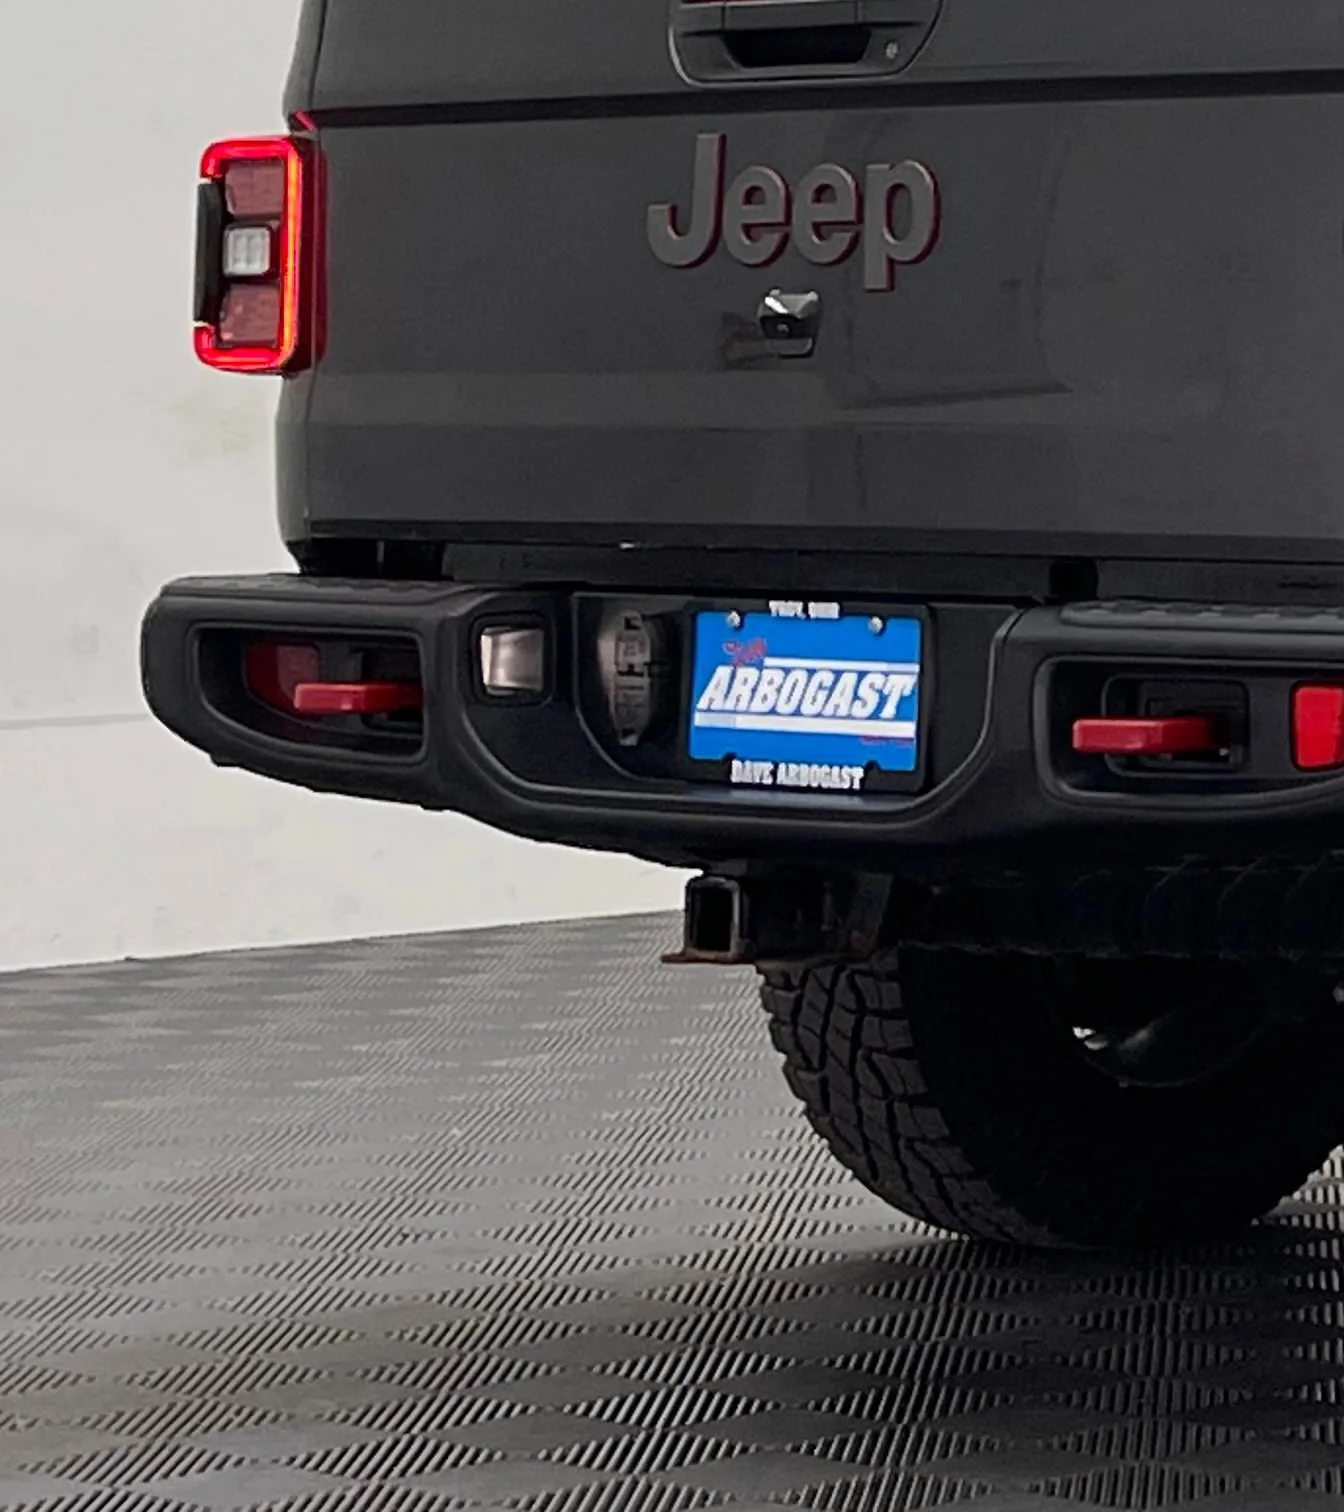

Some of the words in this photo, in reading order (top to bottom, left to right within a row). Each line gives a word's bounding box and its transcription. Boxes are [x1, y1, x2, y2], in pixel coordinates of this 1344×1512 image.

[646, 132, 941, 292] Jeep
[696, 665, 916, 719] ARBOGAST
[730, 758, 775, 785] DAVE
[776, 761, 865, 791] ARBOGAST
